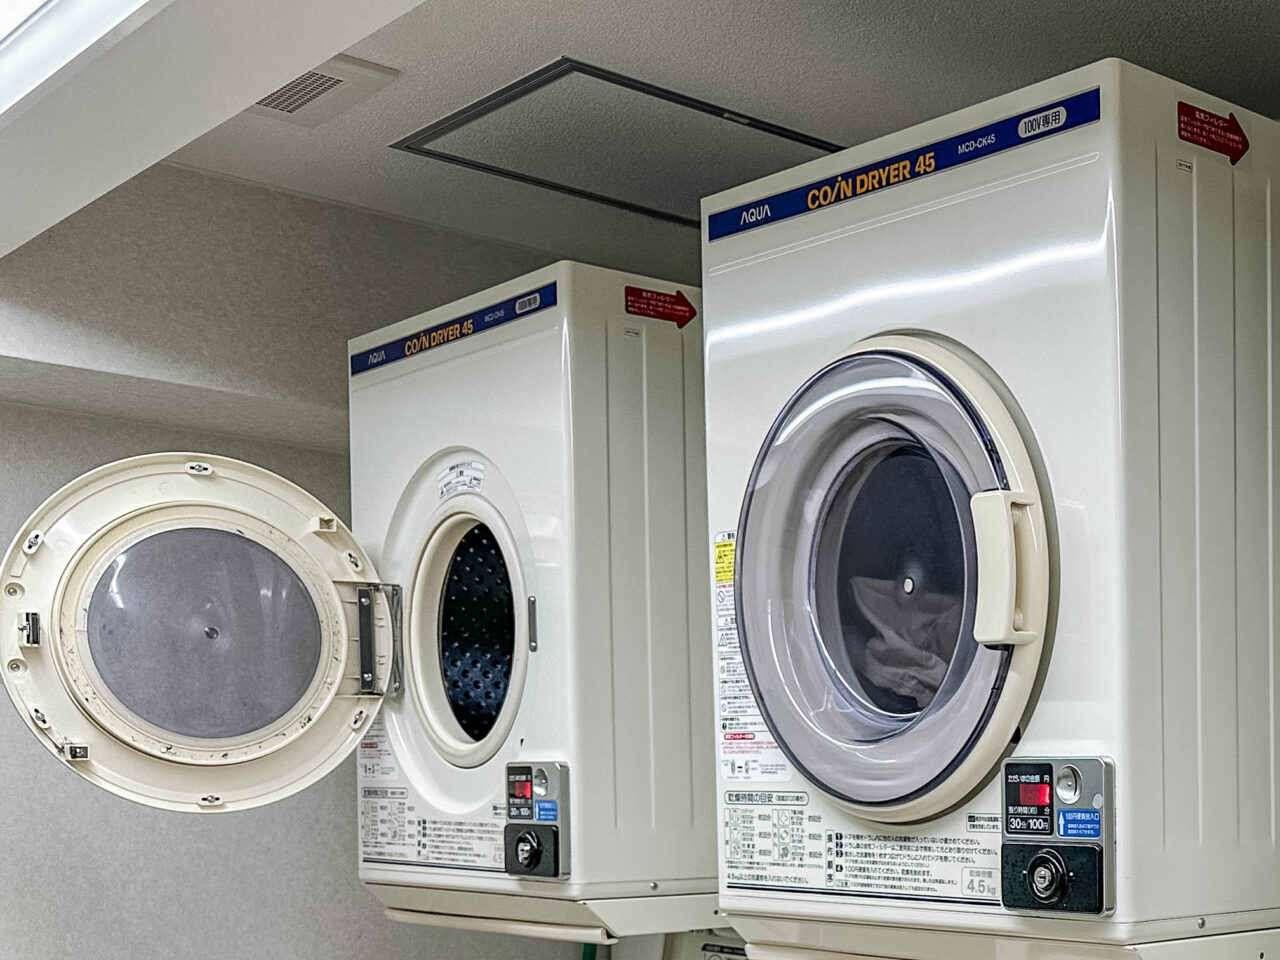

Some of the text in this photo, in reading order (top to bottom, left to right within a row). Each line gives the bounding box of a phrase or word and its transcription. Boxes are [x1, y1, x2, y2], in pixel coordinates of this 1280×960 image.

[740, 110, 1061, 225] AQUA COIN DRYER 45 MCD-CK45 100V専用
[368, 350, 386, 365] AQUA
[405, 332, 430, 356] COIN
[430, 324, 460, 347] DRYER
[462, 319, 474, 335] 45
